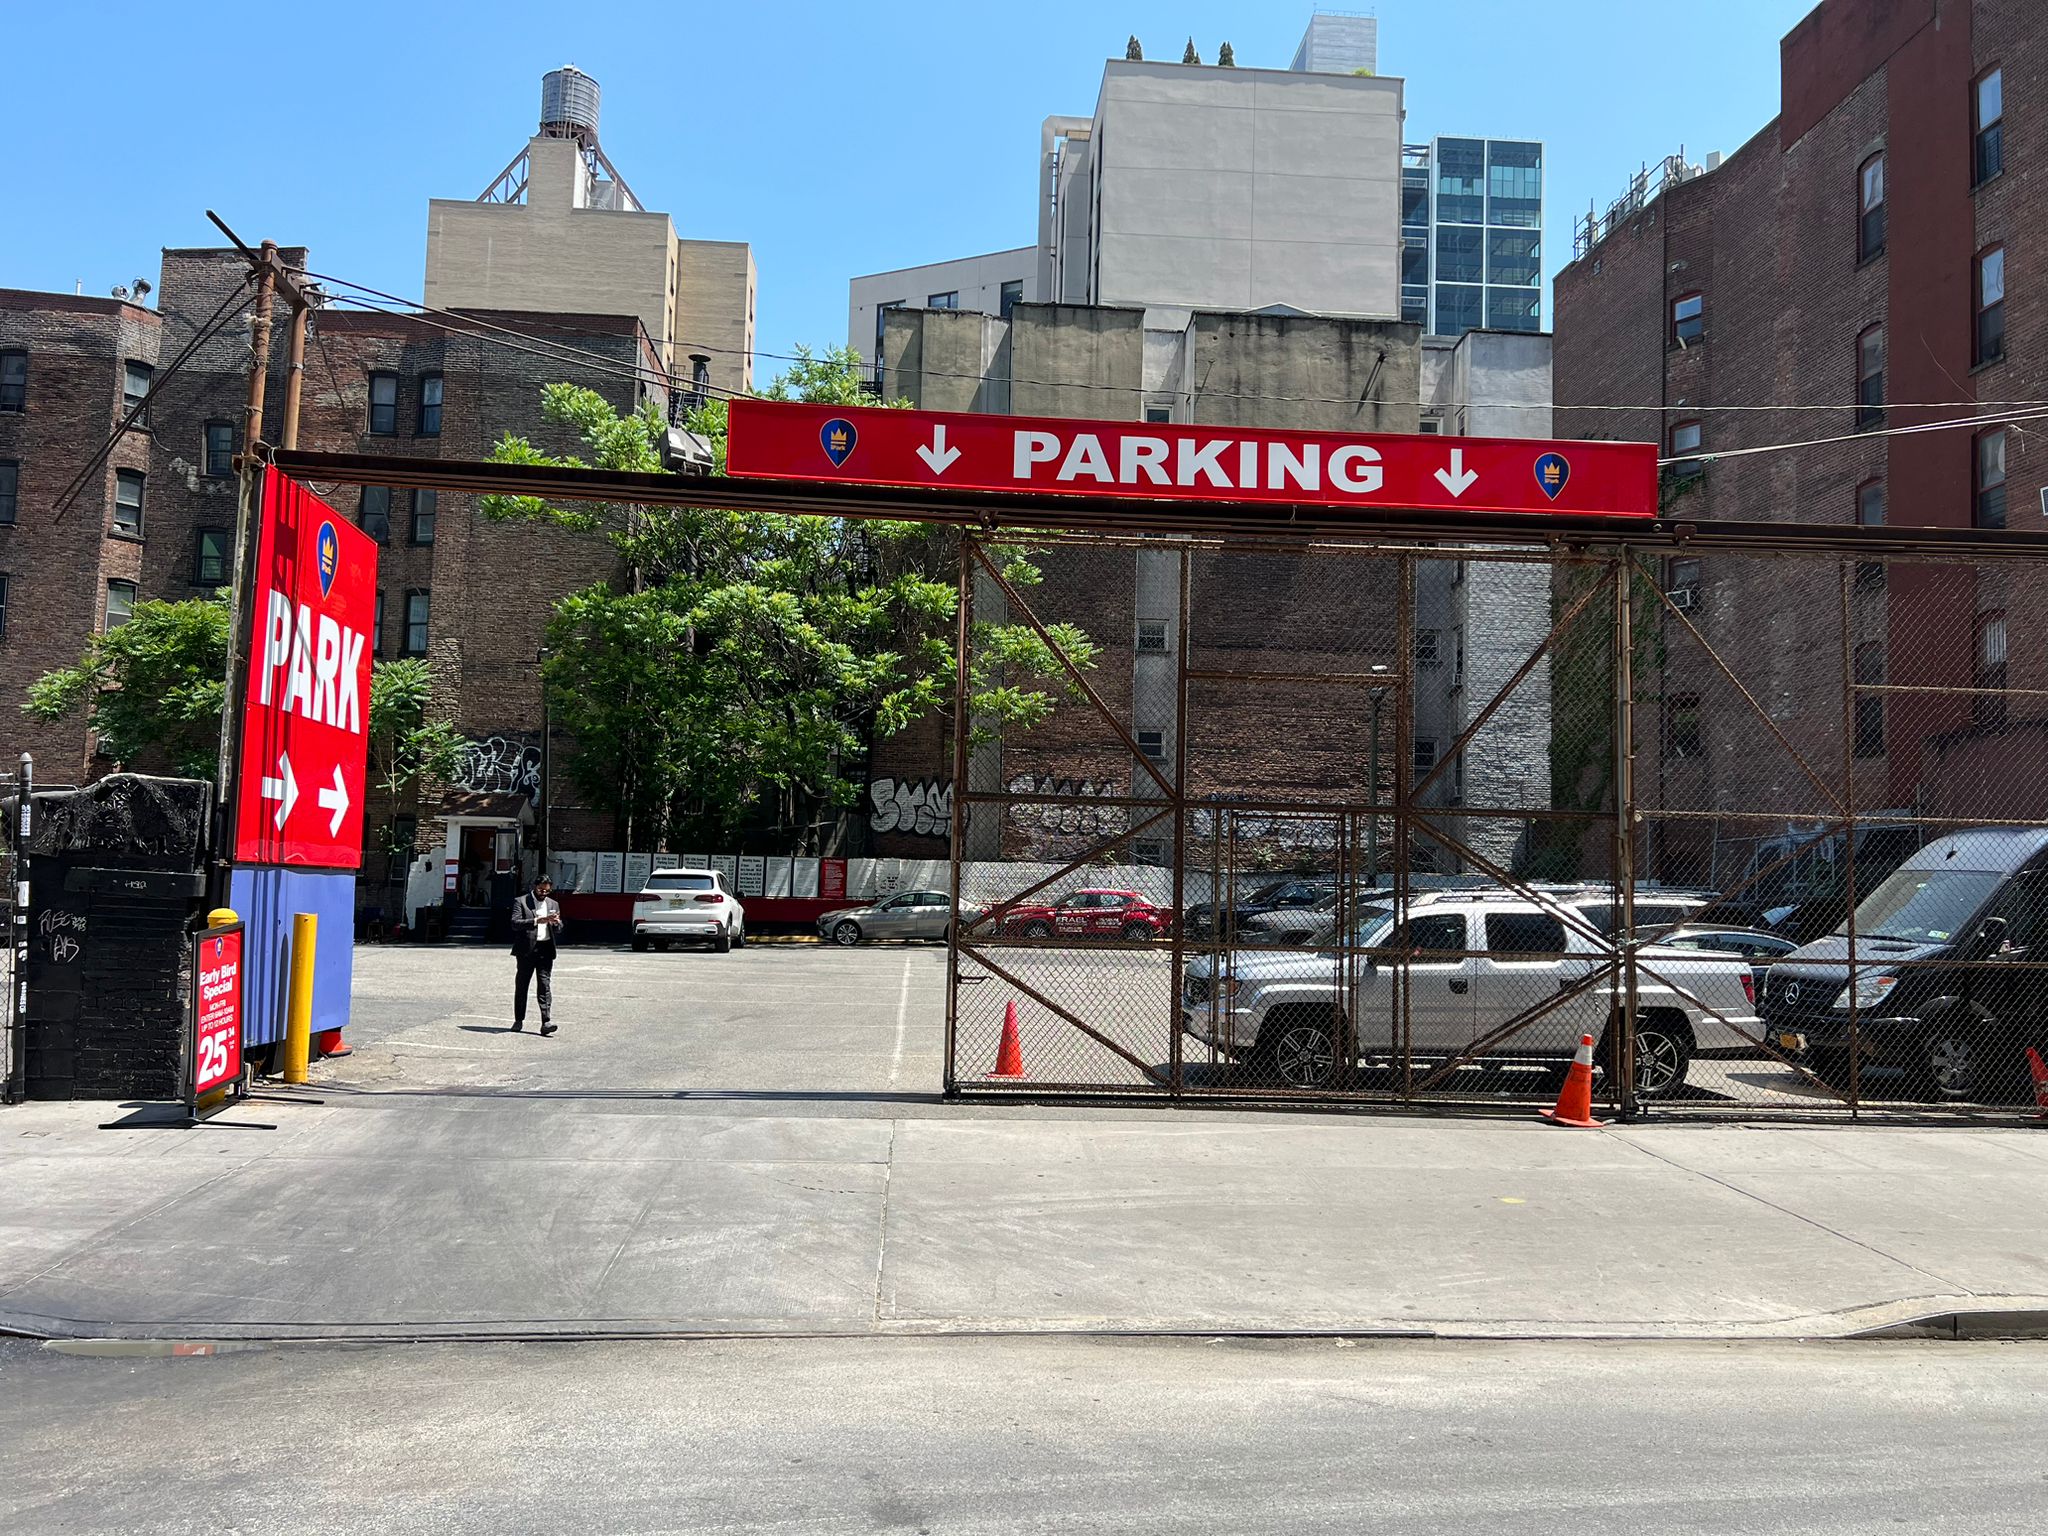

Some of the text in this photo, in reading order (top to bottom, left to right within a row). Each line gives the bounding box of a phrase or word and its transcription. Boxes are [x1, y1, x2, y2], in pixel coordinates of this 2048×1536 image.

[1013, 430, 1384, 493] PARKING
[260, 588, 366, 735] PARK
[199, 962, 237, 986] Early Bird
[203, 977, 233, 1001] Special
[198, 1030, 228, 1085] 25
